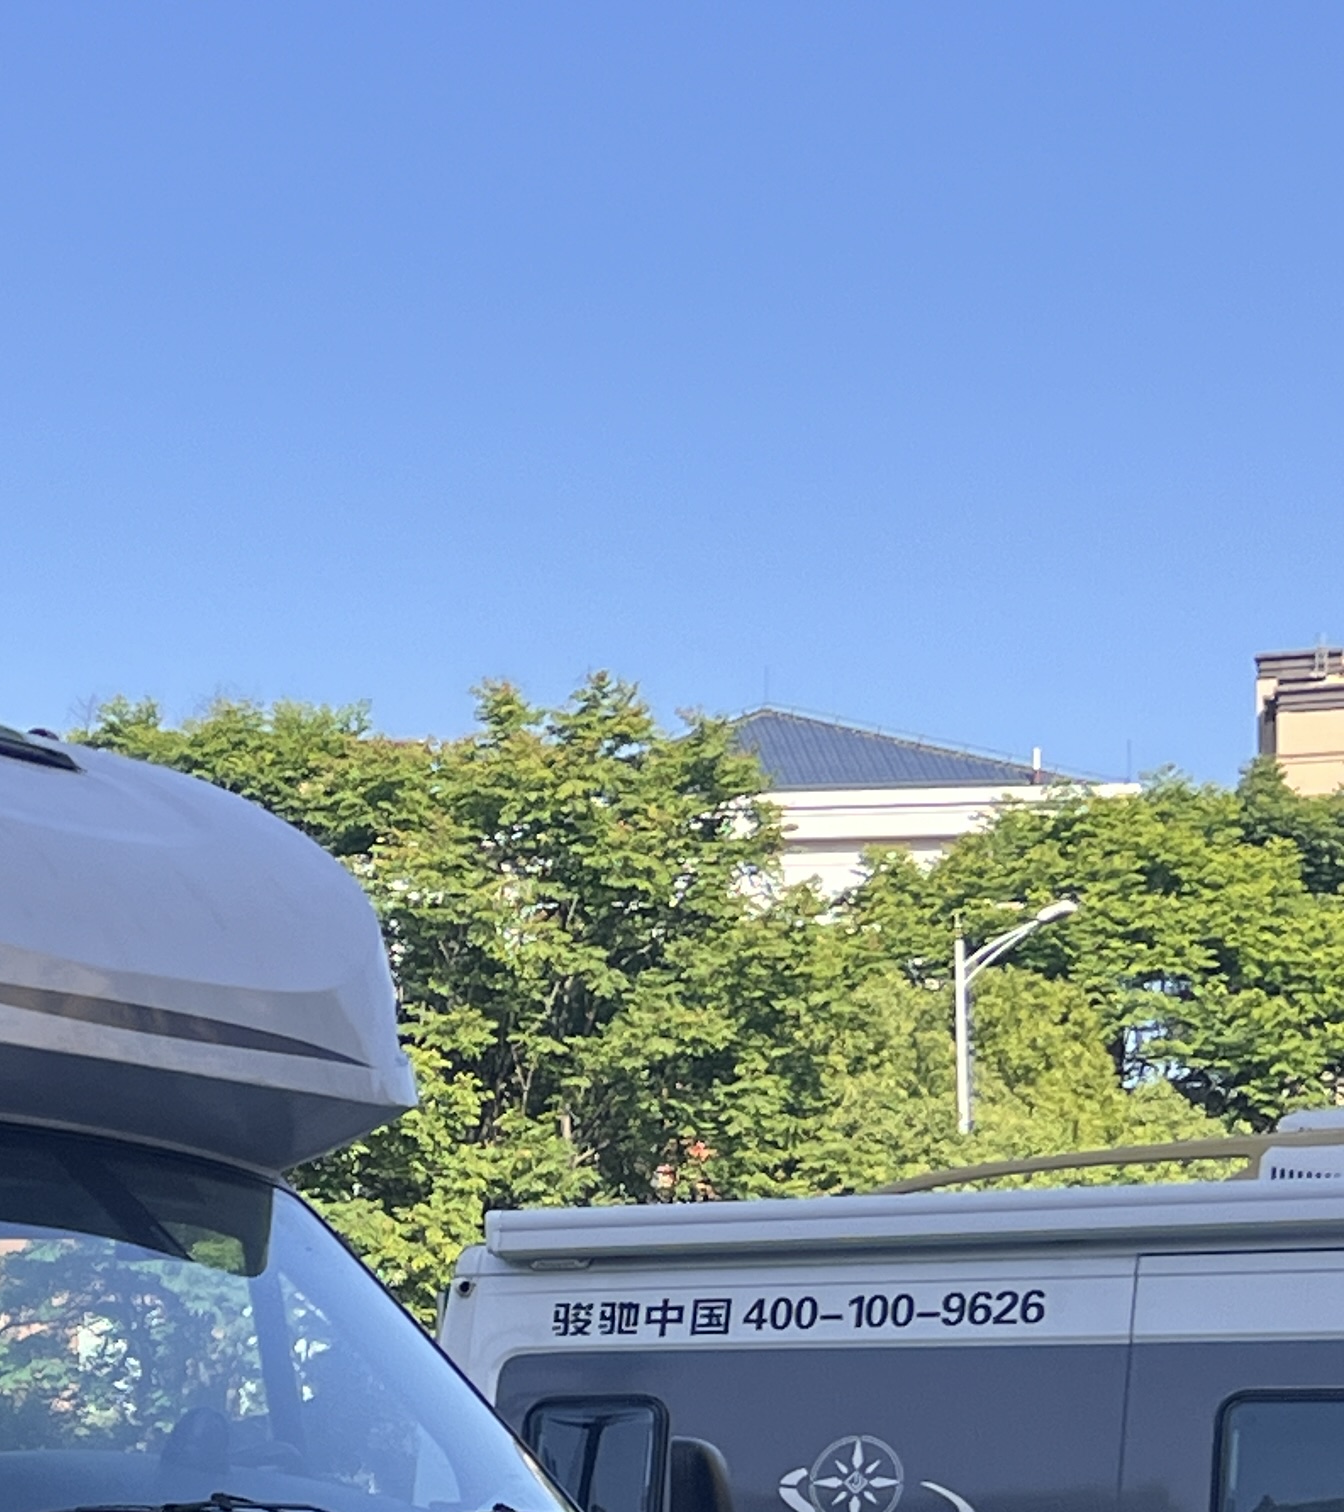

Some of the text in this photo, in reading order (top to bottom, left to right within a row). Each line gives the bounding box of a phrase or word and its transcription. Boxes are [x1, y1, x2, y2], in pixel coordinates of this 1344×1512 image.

[551, 1289, 1047, 1337] 骏驰中国 400-100-9626
